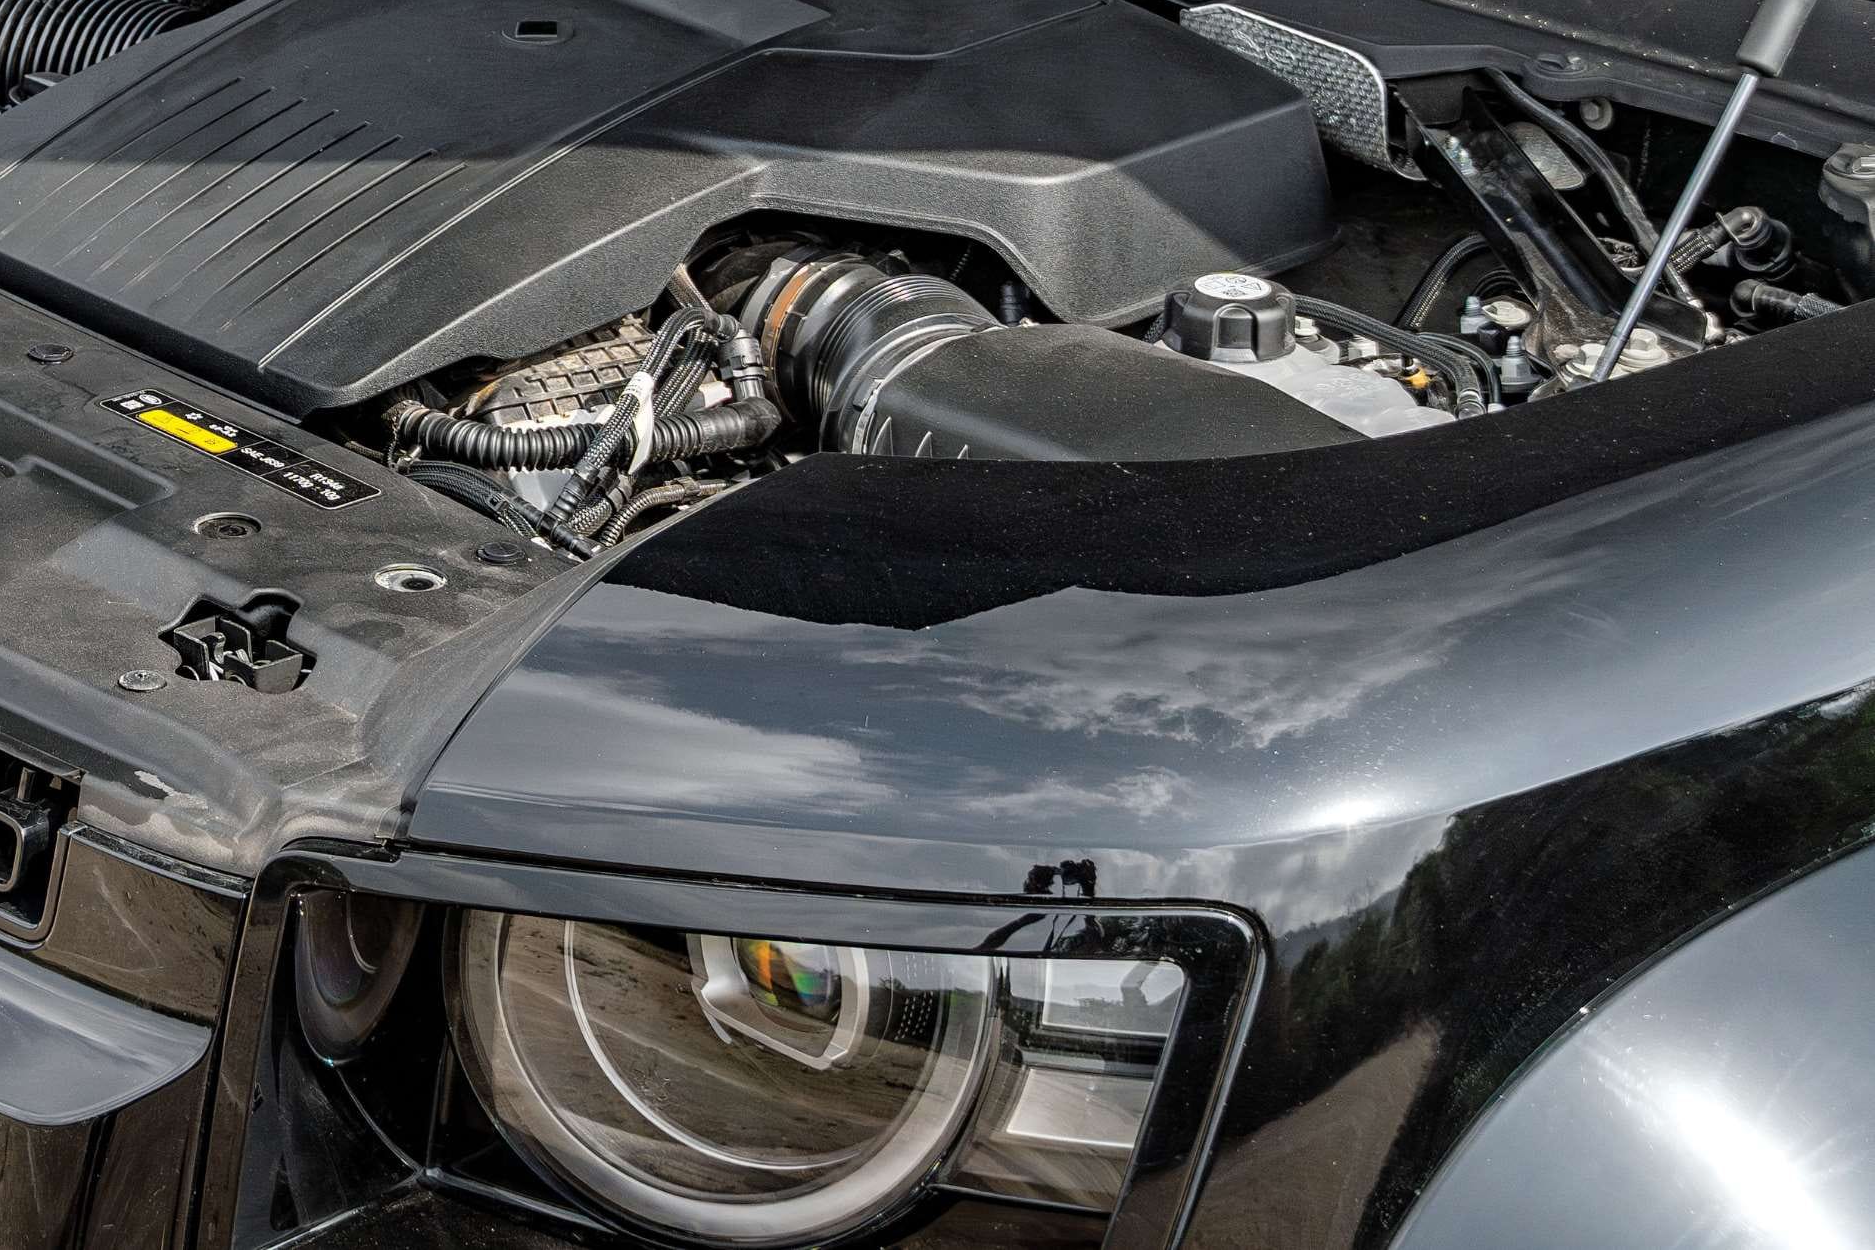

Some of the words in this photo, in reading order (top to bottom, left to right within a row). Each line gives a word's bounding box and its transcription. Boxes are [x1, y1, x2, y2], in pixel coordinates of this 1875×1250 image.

[240, 447, 265, 459] SAE
[283, 472, 314, 488] 1170g
[319, 488, 341, 501] 10g
